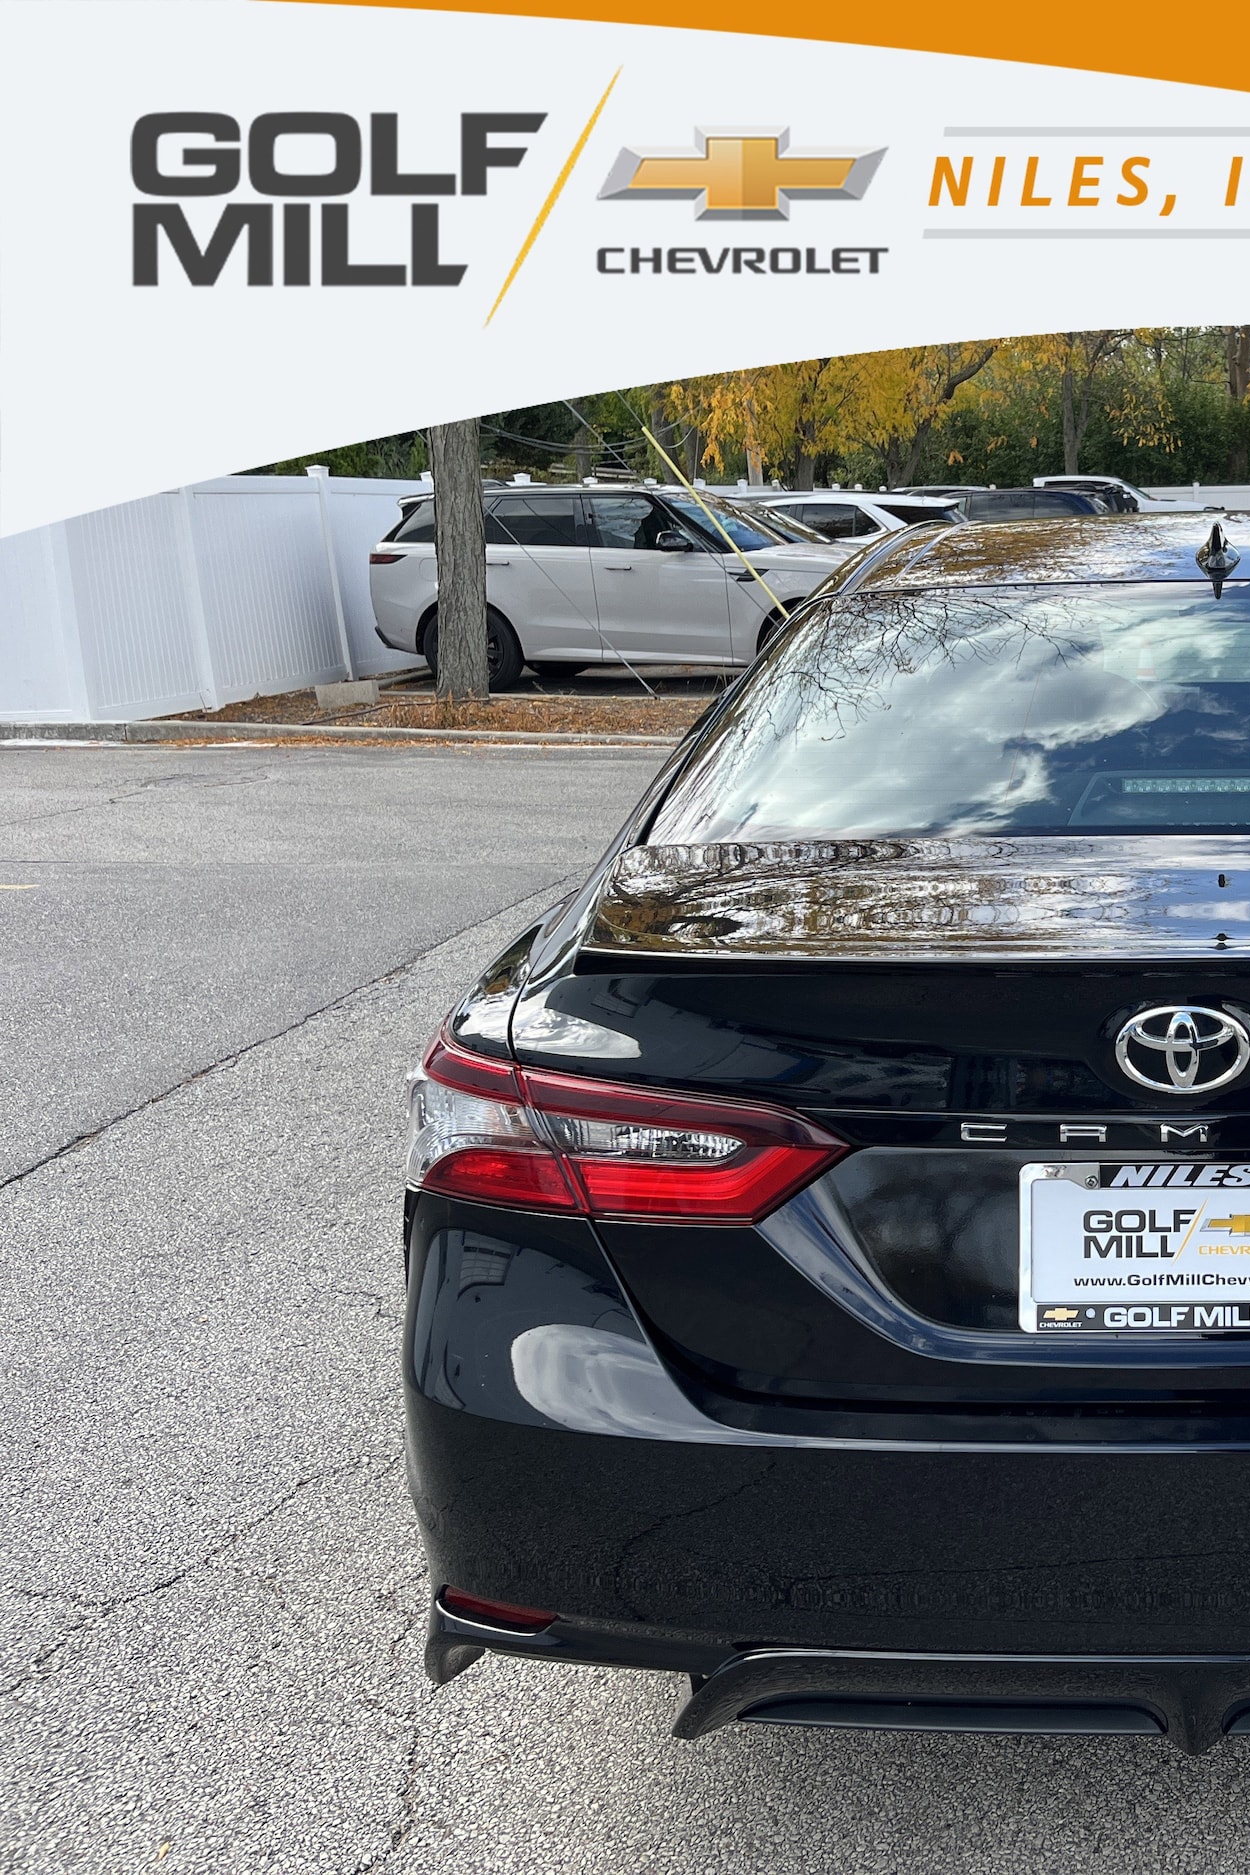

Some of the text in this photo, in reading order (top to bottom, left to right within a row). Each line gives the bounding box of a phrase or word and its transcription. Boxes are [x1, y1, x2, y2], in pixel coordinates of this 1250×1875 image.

[1083, 1209, 1197, 1233] GOLF
[1084, 1235, 1175, 1259] MILL
[1038, 1321, 1083, 1329] CHEVROLET
[1103, 1306, 1190, 1328] GOLF
